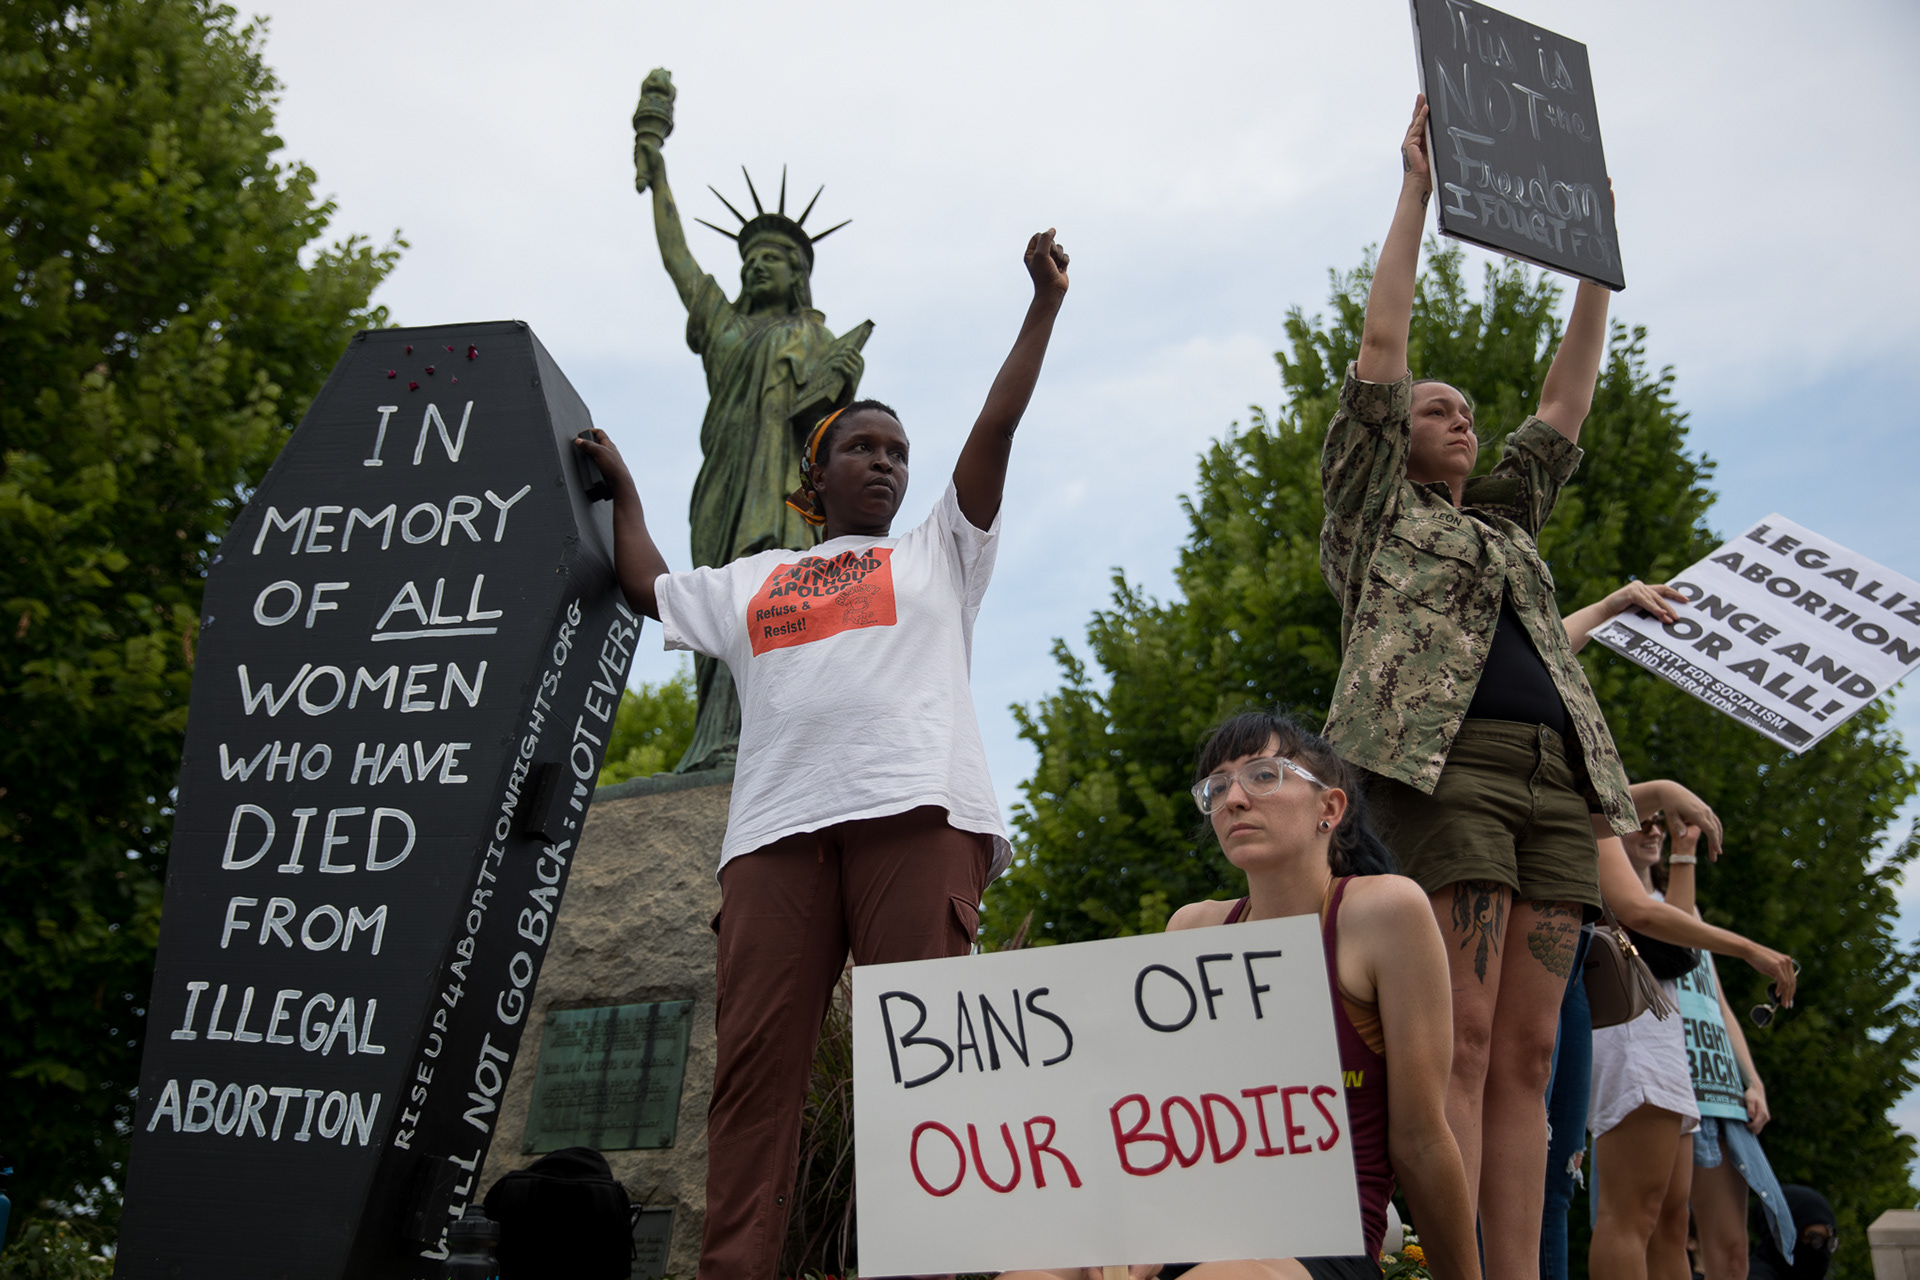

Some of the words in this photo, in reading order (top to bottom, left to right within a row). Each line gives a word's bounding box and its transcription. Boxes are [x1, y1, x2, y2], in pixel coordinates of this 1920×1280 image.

[1533, 34, 1577, 94] is
[1435, 56, 1547, 141] NOT
[1444, 181, 1477, 219] I
[1447, 126, 1602, 235] Freedom
[363, 400, 474, 466] IN
[253, 485, 531, 555] MEMORY
[1431, 512, 1463, 527] LEON
[253, 580, 349, 628] OF
[376, 574, 503, 630] ALL
[755, 603, 797, 623] Refuse
[801, 600, 811, 611] &
[763, 617, 807, 639] Resist!
[1709, 551, 1920, 666] ABORTION
[1601, 628, 1631, 648] PSL
[1635, 608, 1733, 662] OR
[1725, 657, 1845, 723] ALL!
[1671, 581, 1781, 646] ONCE
[1771, 641, 1878, 699] AND
[237, 660, 488, 717] WOMEN
[1628, 645, 1661, 667] AND
[1658, 662, 1737, 713] LIBERATION
[1640, 639, 1684, 667] PARTY
[1684, 666, 1713, 686] FOR
[1712, 682, 1789, 730] SOCIALISM
[219, 741, 332, 783] WHO
[350, 741, 471, 785] HAVE
[221, 803, 416, 874] DIED
[462, 1033, 510, 1134] NOT
[496, 951, 534, 1026] GO
[583, 602, 639, 723] EVER!
[220, 897, 387, 955] FROM
[170, 981, 386, 1056] ILLEGAL
[878, 987, 1074, 1089] BANS
[1133, 949, 1282, 1033] OFF
[147, 1079, 381, 1146] ABORTION
[909, 1115, 1083, 1197] OUR
[1108, 1085, 1340, 1177] BODIES
